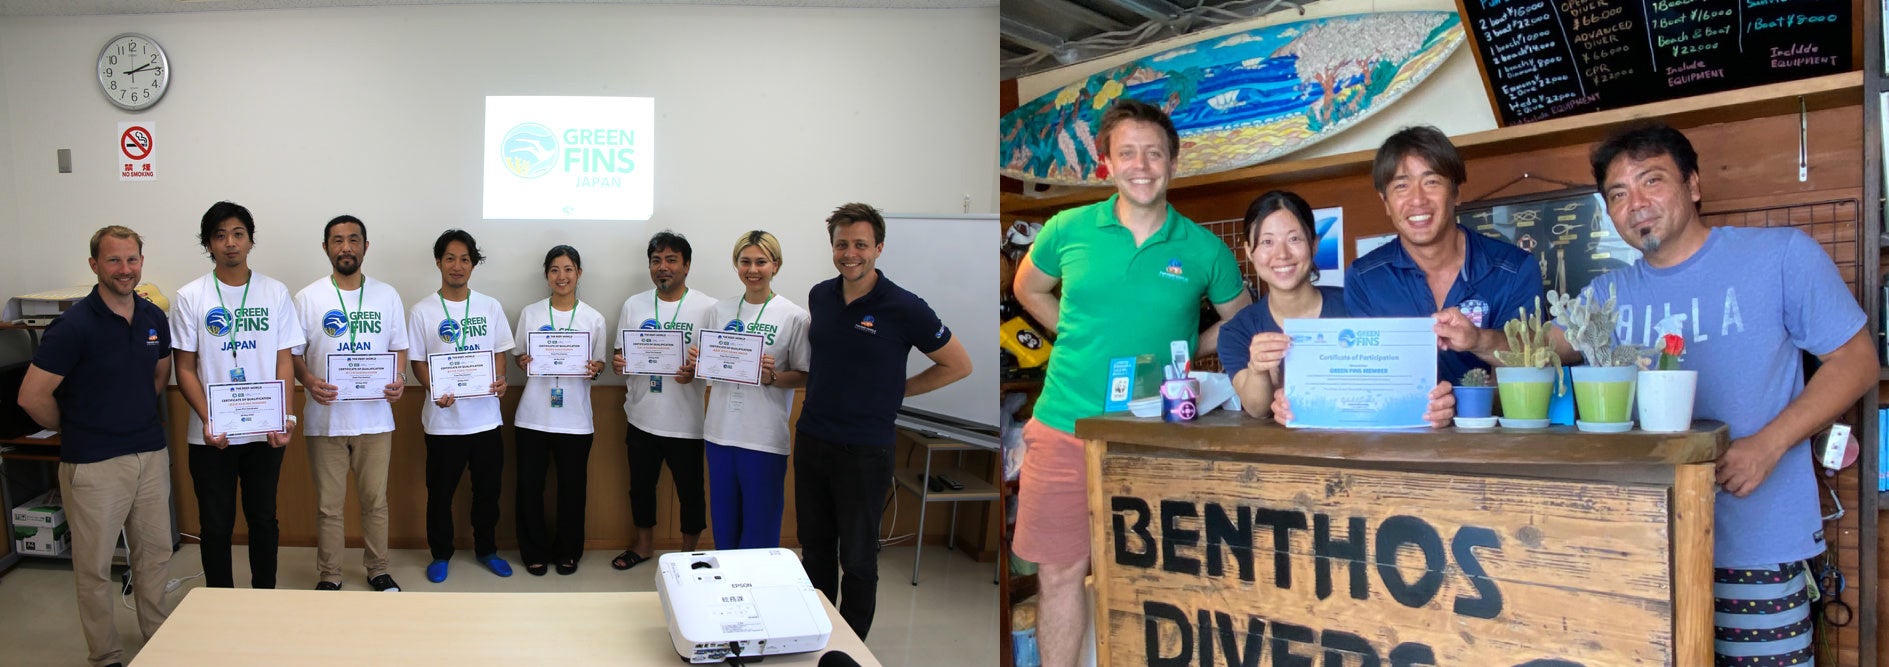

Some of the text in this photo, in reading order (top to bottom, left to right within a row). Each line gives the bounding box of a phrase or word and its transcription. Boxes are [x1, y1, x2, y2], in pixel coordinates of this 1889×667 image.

[1479, 19, 1487, 30] 2
[1489, 13, 1507, 26] boat
[1660, 12, 1687, 28] Boat
[1755, 16, 1785, 30] Boat
[1484, 32, 1492, 41] 3
[1492, 23, 1512, 37] boat
[1574, 20, 1633, 43] ADVANCED
[1658, 31, 1688, 47] Beach
[1705, 25, 1731, 36] Boat
[128, 42, 137, 52] 12
[1495, 37, 1520, 52] beach
[1584, 34, 1619, 49] DIVER
[117, 46, 124, 55] 11
[1770, 43, 1819, 57] Include
[109, 55, 118, 65] 10
[150, 54, 157, 64] 2
[1771, 56, 1838, 68] EQUIPMENT
[106, 68, 113, 78] 9
[154, 67, 161, 76] 3
[1585, 63, 1611, 77] CPR
[1665, 60, 1706, 75] Include
[151, 79, 158, 88] 4
[1667, 69, 1724, 87] EQUIPMENT
[110, 81, 117, 90] 8
[120, 89, 127, 99] 7
[131, 92, 138, 102] 6
[143, 89, 150, 98] 5
[563, 128, 605, 146] GREEN
[564, 147, 605, 173] FINS
[576, 176, 621, 188] JAPAN
[234, 307, 269, 318] GREEN
[349, 311, 381, 320] GREEN
[235, 318, 269, 332] FINS
[460, 317, 487, 327] GREEN
[663, 321, 693, 331] GREEN
[747, 322, 778, 333] GREEN
[462, 325, 487, 338] FINS
[221, 340, 257, 351] JAPAN
[337, 341, 371, 352] JAPAN
[1357, 337, 1379, 346] FINS
[1359, 354, 1399, 362] Participation
[1111, 495, 1504, 620] BENTHOS
